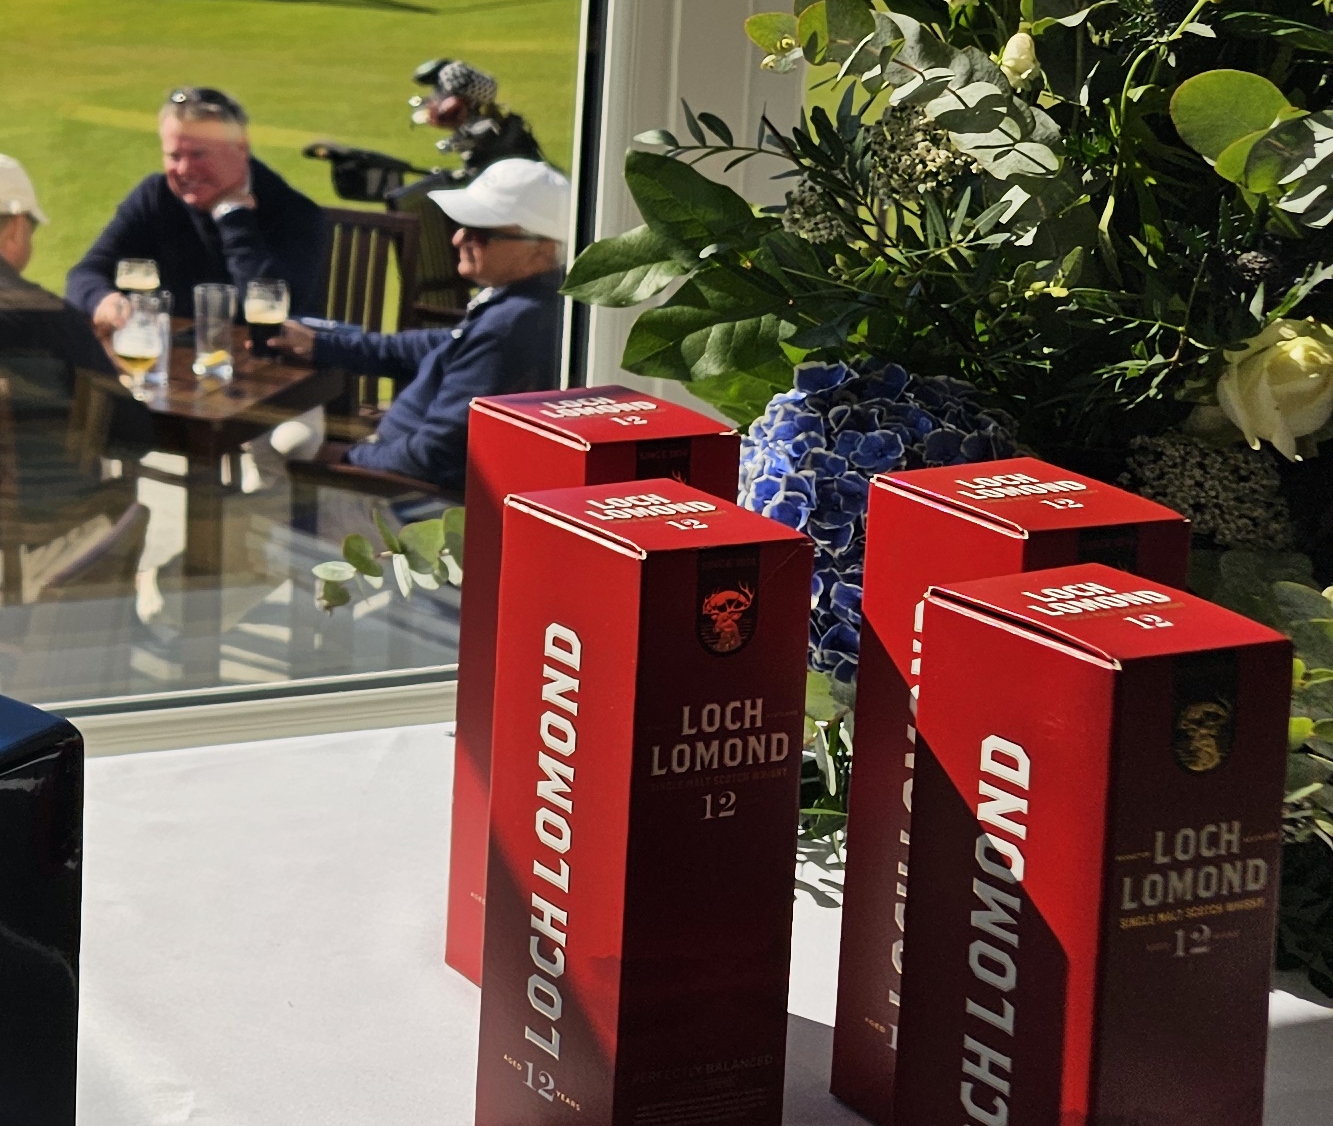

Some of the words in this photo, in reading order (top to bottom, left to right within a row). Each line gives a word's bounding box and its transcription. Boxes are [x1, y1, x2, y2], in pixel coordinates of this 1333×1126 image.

[538, 400, 658, 419] LOMOND
[542, 396, 617, 410] LOCH
[611, 415, 648, 426] 12
[955, 473, 1040, 489] LOCH
[956, 480, 1086, 500] LOMOND
[584, 493, 671, 510] LOCH
[584, 500, 717, 521] LOMOND
[1039, 498, 1084, 510] 12
[664, 518, 709, 531] 12
[1021, 582, 1116, 603] LOCH
[1026, 590, 1171, 616] LOMOND
[1123, 613, 1174, 630] 12
[680, 697, 764, 737] LOCH
[532, 621, 583, 894] LOMOND
[650, 732, 790, 777] LOMOND
[700, 790, 737, 821] 12
[1154, 820, 1242, 865] LOCH
[965, 734, 1031, 1038] LOMOND
[1120, 858, 1268, 910] LOMOND
[1173, 924, 1212, 957] 12
[525, 892, 568, 1061] LOCH
[886, 1022, 899, 1052] 1
[503, 1053, 522, 1071] AGED
[522, 1059, 556, 1103] 12
[555, 1090, 581, 1112] YEARS
[960, 1034, 1012, 1126] CH
